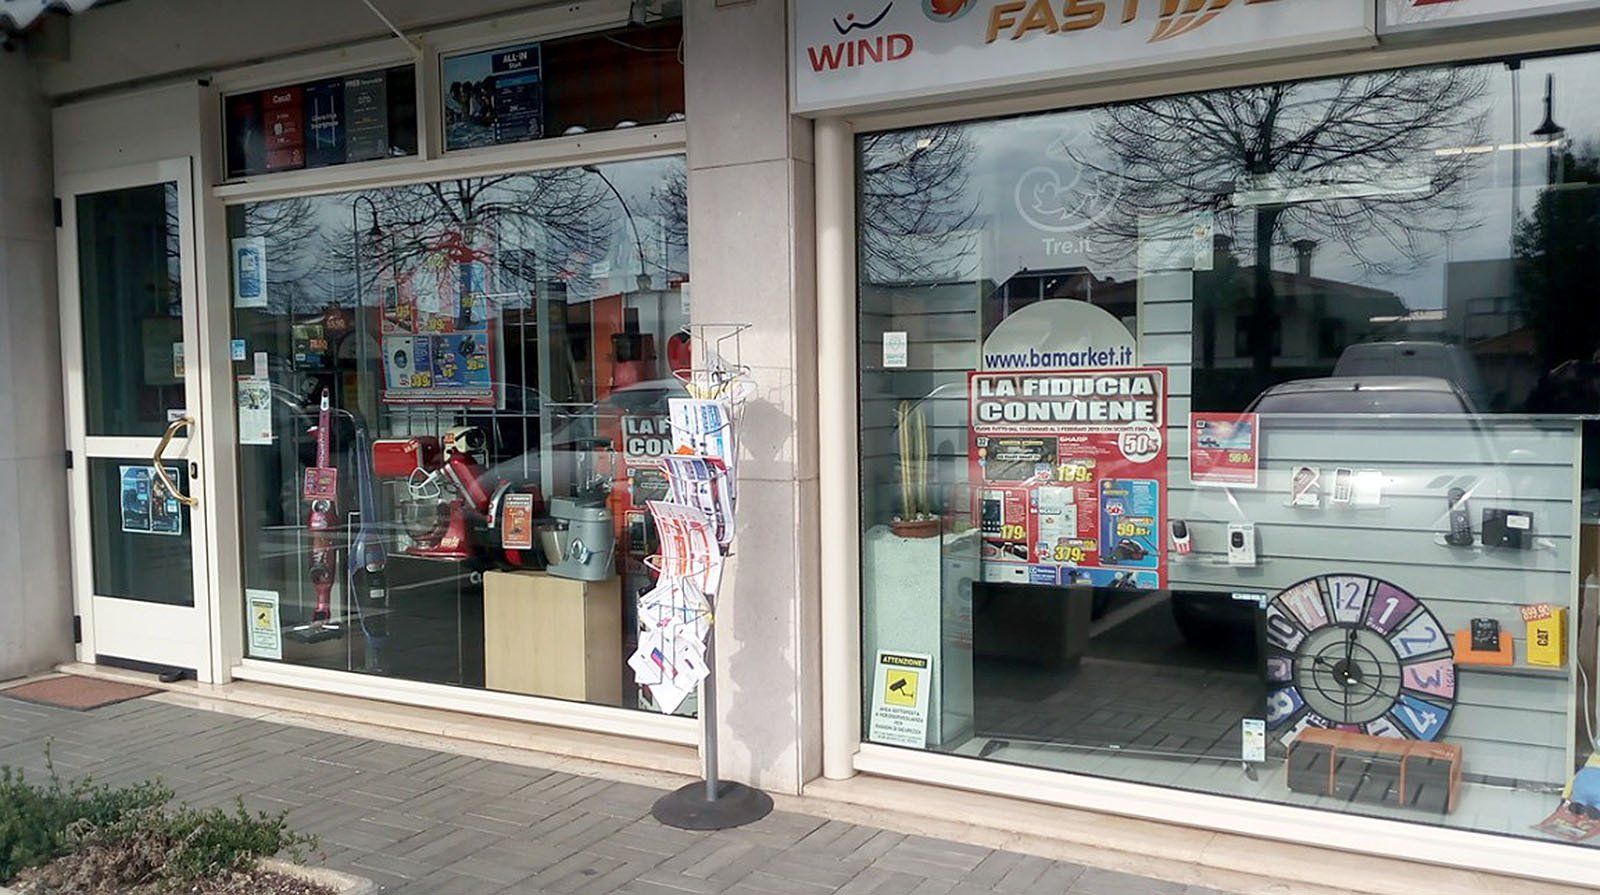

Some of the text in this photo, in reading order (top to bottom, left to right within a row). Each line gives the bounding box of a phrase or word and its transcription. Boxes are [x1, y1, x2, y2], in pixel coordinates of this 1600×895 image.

[807, 33, 914, 72] WIND
[1041, 238, 1092, 255] Tre.it
[985, 346, 1132, 368] www.bamarket.it
[980, 376, 1153, 397] LA FIDUCIA
[979, 399, 1154, 421] CONVIENE
[628, 419, 655, 434] LA
[1335, 582, 1361, 610] 12
[1379, 597, 1400, 625] 1
[1399, 626, 1437, 655] 2
[1536, 628, 1549, 647] CAT
[882, 656, 926, 667] ATTENZIONE!
[1409, 666, 1443, 689] 3
[1401, 700, 1438, 734] 4
